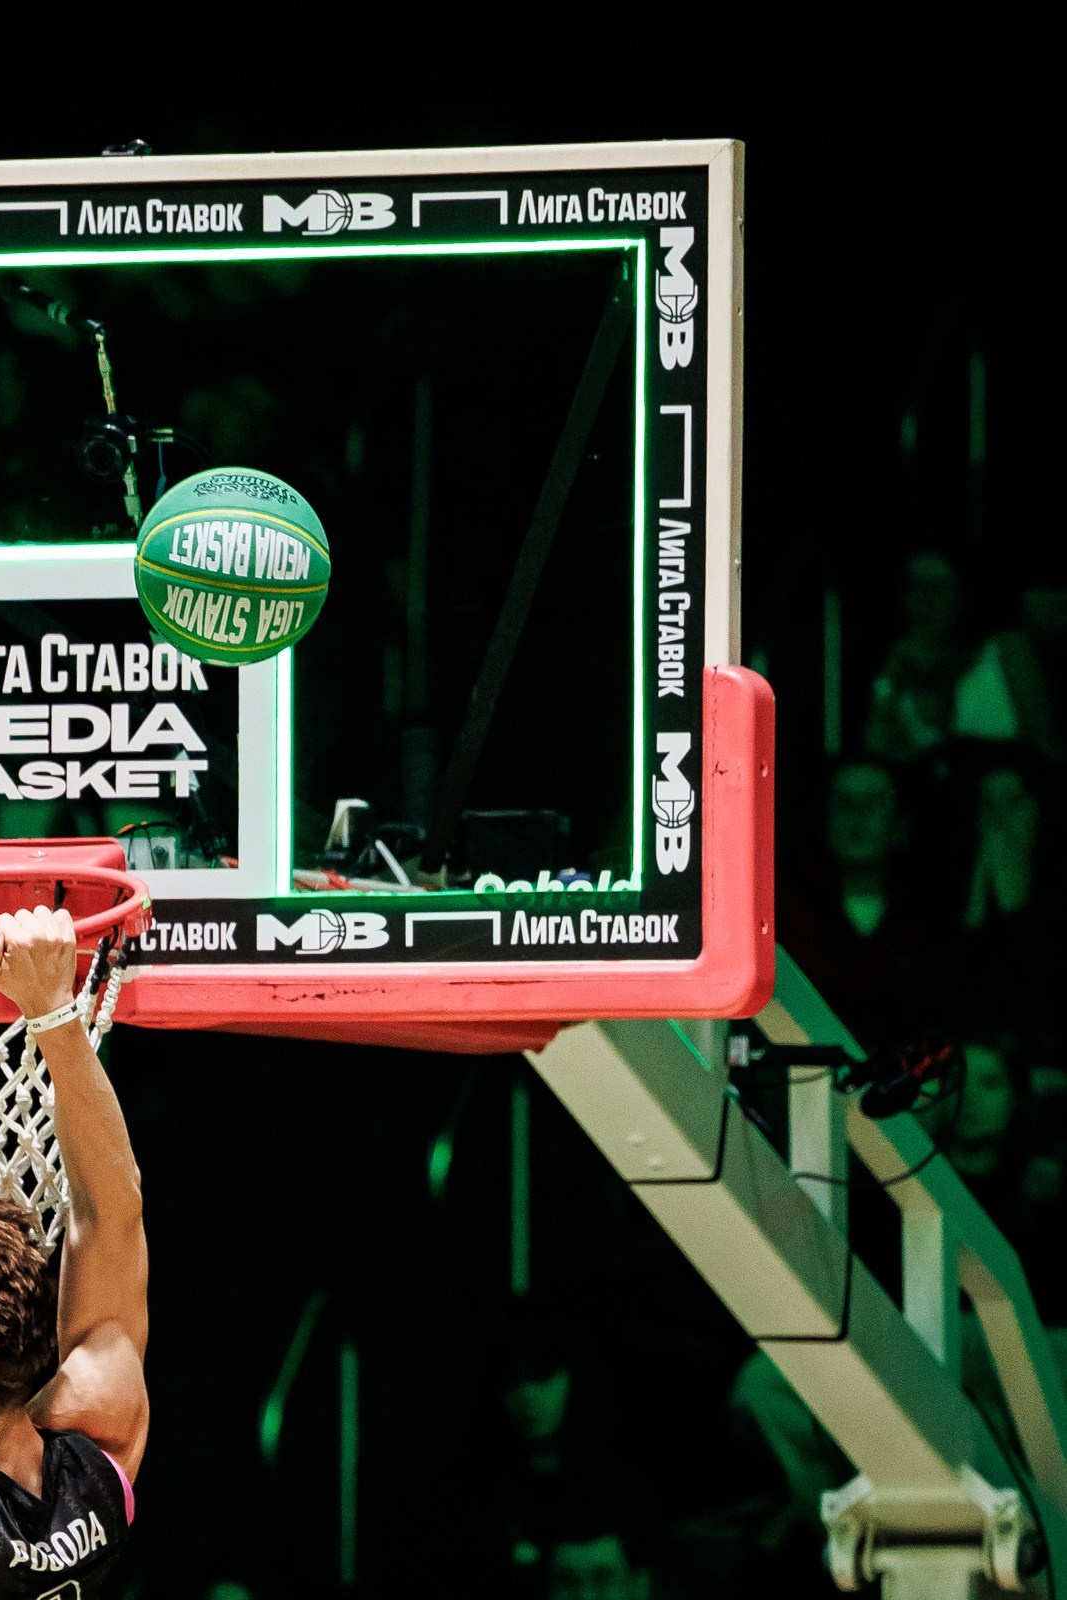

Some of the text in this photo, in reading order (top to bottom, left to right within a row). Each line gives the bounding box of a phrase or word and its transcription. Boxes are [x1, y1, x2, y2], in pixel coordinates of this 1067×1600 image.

[168, 520, 311, 580] MEDIA BASKET
[162, 584, 305, 645] LIGA STAVOK
